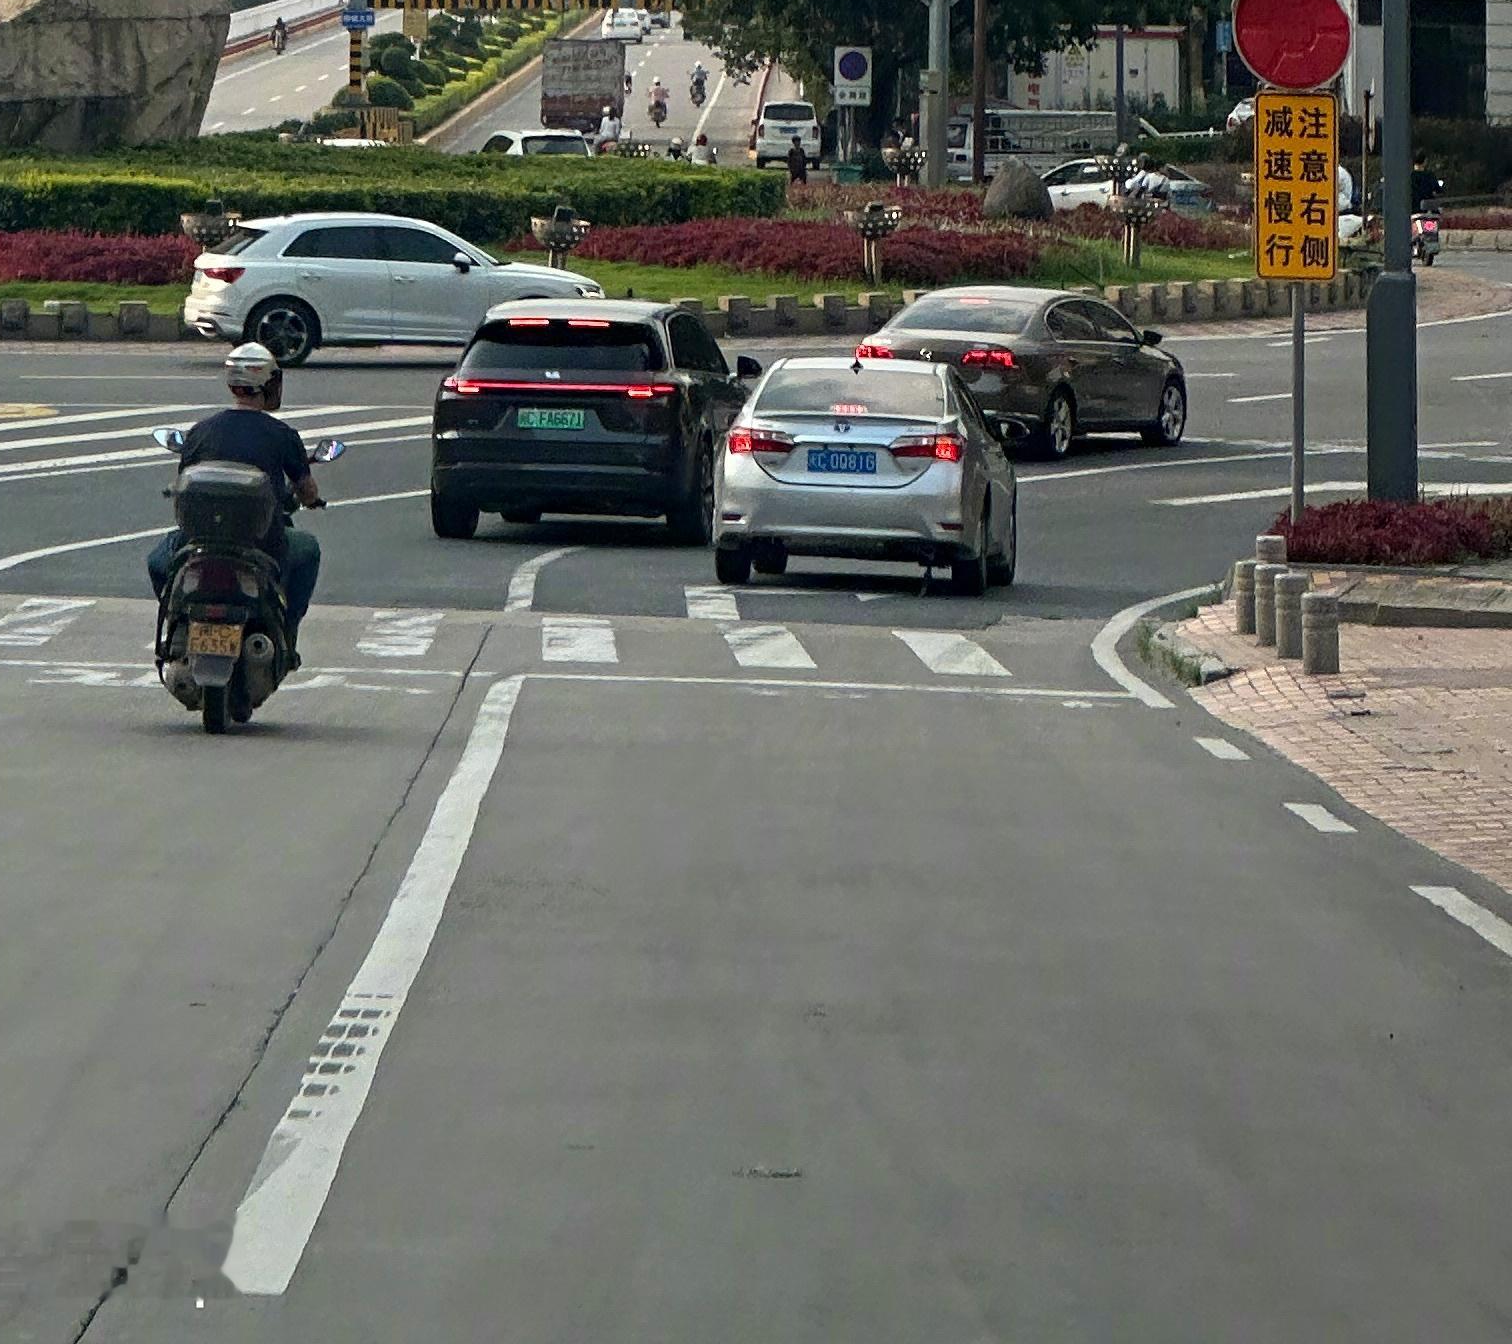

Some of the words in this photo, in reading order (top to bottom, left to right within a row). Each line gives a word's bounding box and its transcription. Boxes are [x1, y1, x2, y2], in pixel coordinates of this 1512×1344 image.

[1264, 105, 1295, 268] 减速慢行
[1298, 106, 1330, 268] 注意右侧
